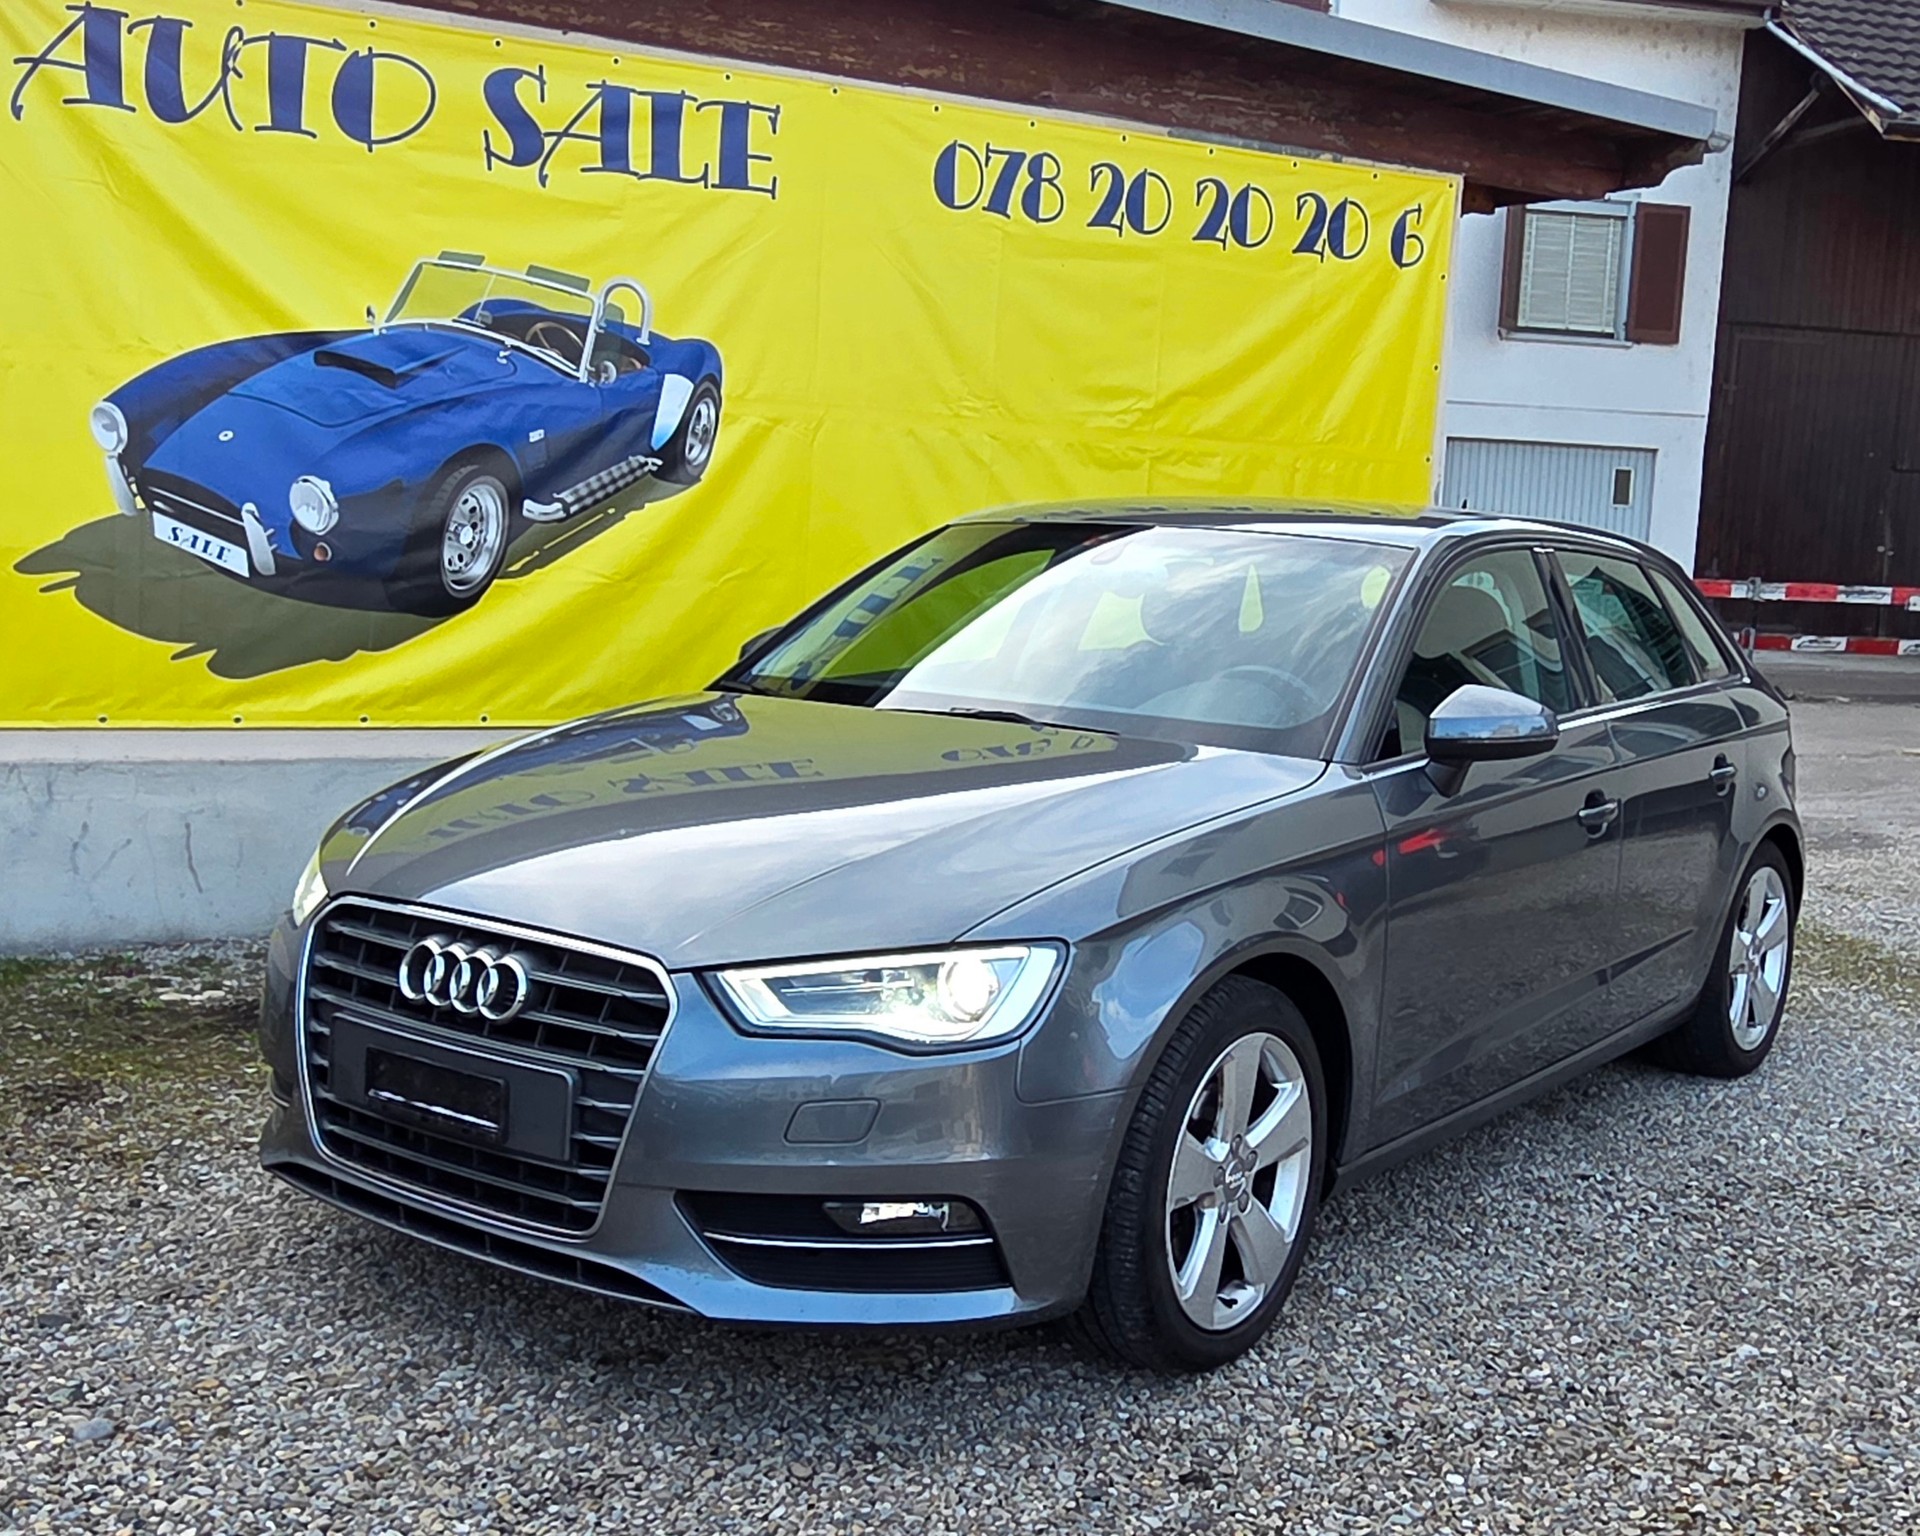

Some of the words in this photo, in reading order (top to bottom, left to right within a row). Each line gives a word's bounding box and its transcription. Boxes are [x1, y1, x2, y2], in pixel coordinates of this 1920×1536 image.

[11, 1, 436, 152] AUTO
[483, 65, 781, 200] SALE
[933, 140, 1064, 223] 078
[1087, 162, 1172, 237] 20
[1191, 178, 1274, 250] 20
[1291, 192, 1369, 263] 20
[1390, 203, 1424, 269] 6
[168, 526, 231, 563] SALE
